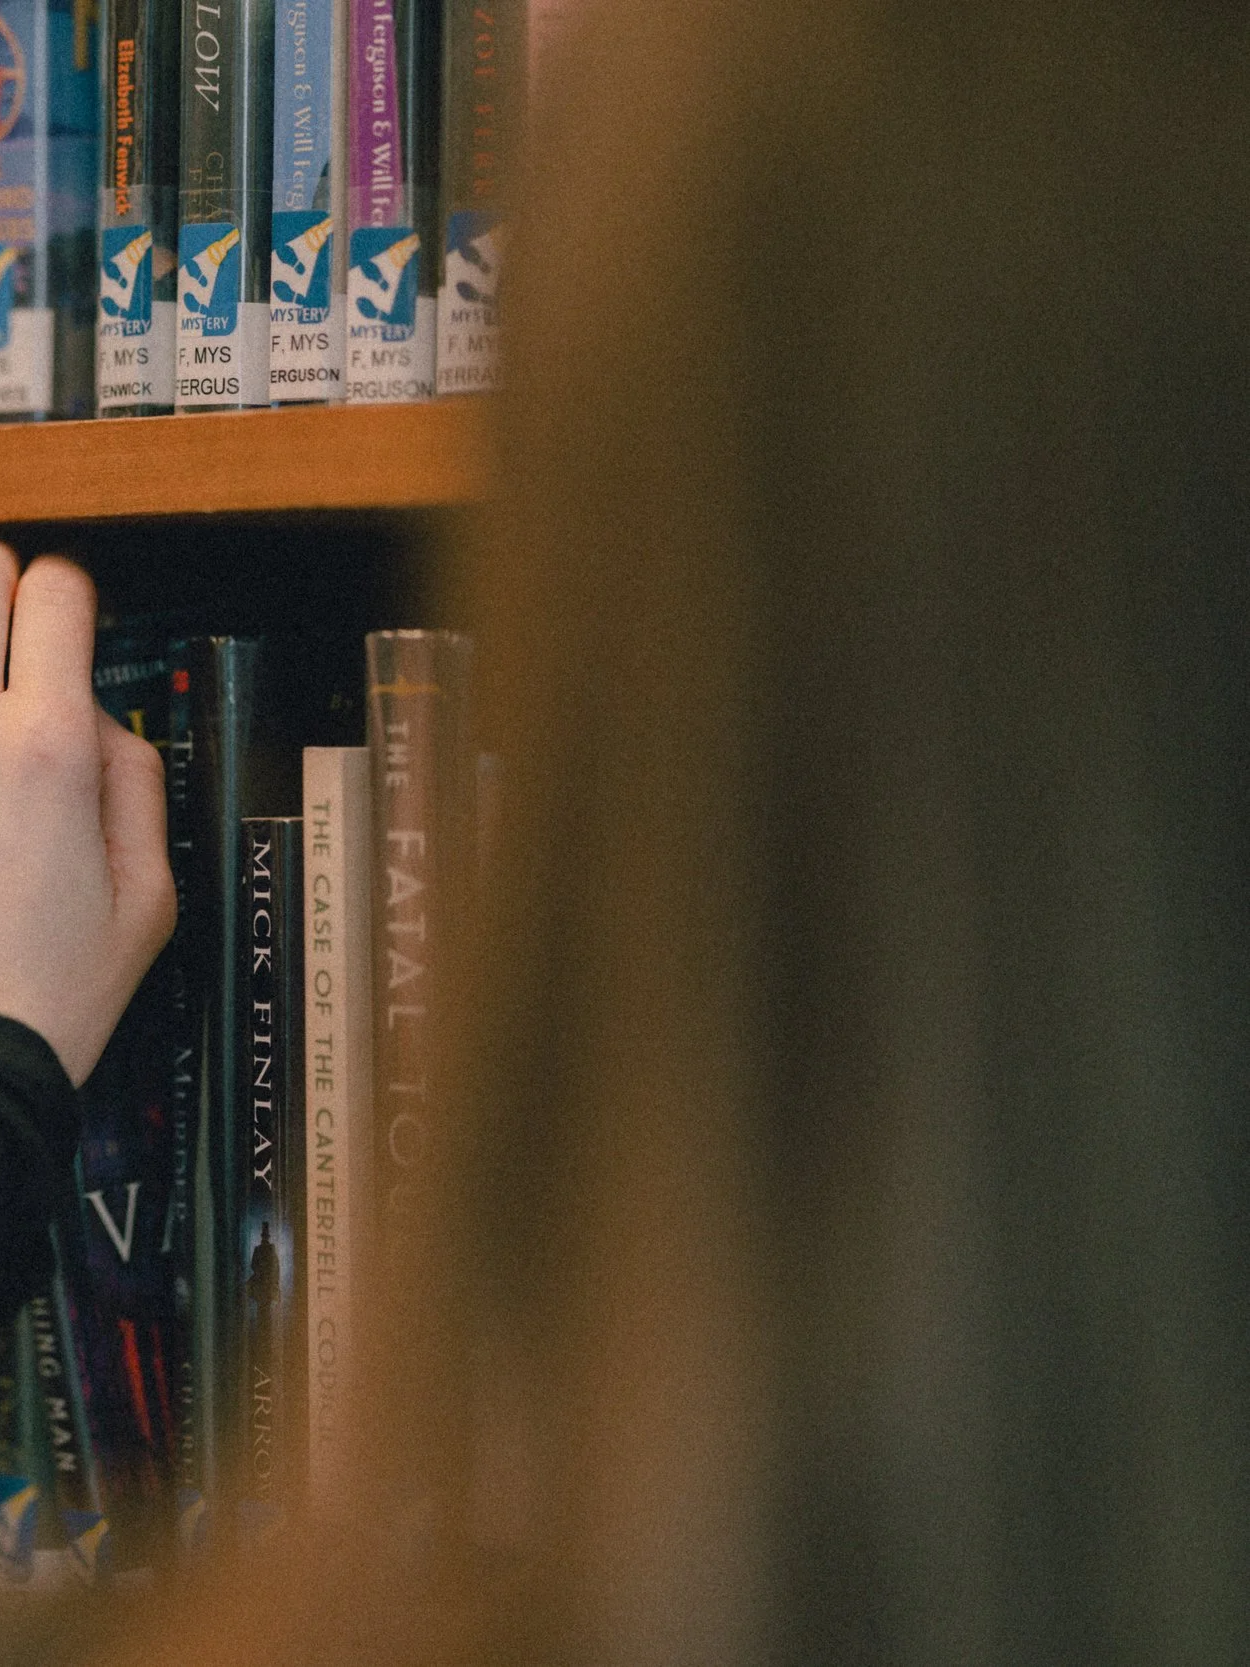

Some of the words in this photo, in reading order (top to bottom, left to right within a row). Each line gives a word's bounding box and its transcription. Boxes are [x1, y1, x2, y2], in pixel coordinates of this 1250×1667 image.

[117, 38, 135, 130] Elizabeth
[365, 13, 393, 113] Ferguson
[293, 84, 312, 100] &
[293, 106, 314, 153] Will
[372, 120, 391, 138] &
[115, 135, 134, 216] Fenwick
[285, 159, 311, 210] Ferg
[372, 142, 394, 191] Will
[181, 316, 230, 331] MYSTERY
[269, 307, 329, 323] MYSTERY
[113, 346, 150, 366] MYS
[194, 345, 232, 364] MYS
[290, 332, 329, 352] MYS
[370, 345, 411, 368] MYS
[270, 367, 340, 384] ERGUSON
[387, 722, 410, 791] THE
[312, 802, 331, 857] THE
[253, 838, 272, 974] MICK
[313, 873, 332, 954] CASE
[386, 829, 427, 1031] FATAL
[313, 970, 333, 1015] OF
[314, 1033, 334, 1093] THE
[253, 1001, 273, 1191] FINLAY
[314, 1107, 337, 1297] CANTERFELL
[46, 1396, 77, 1472] MAN
